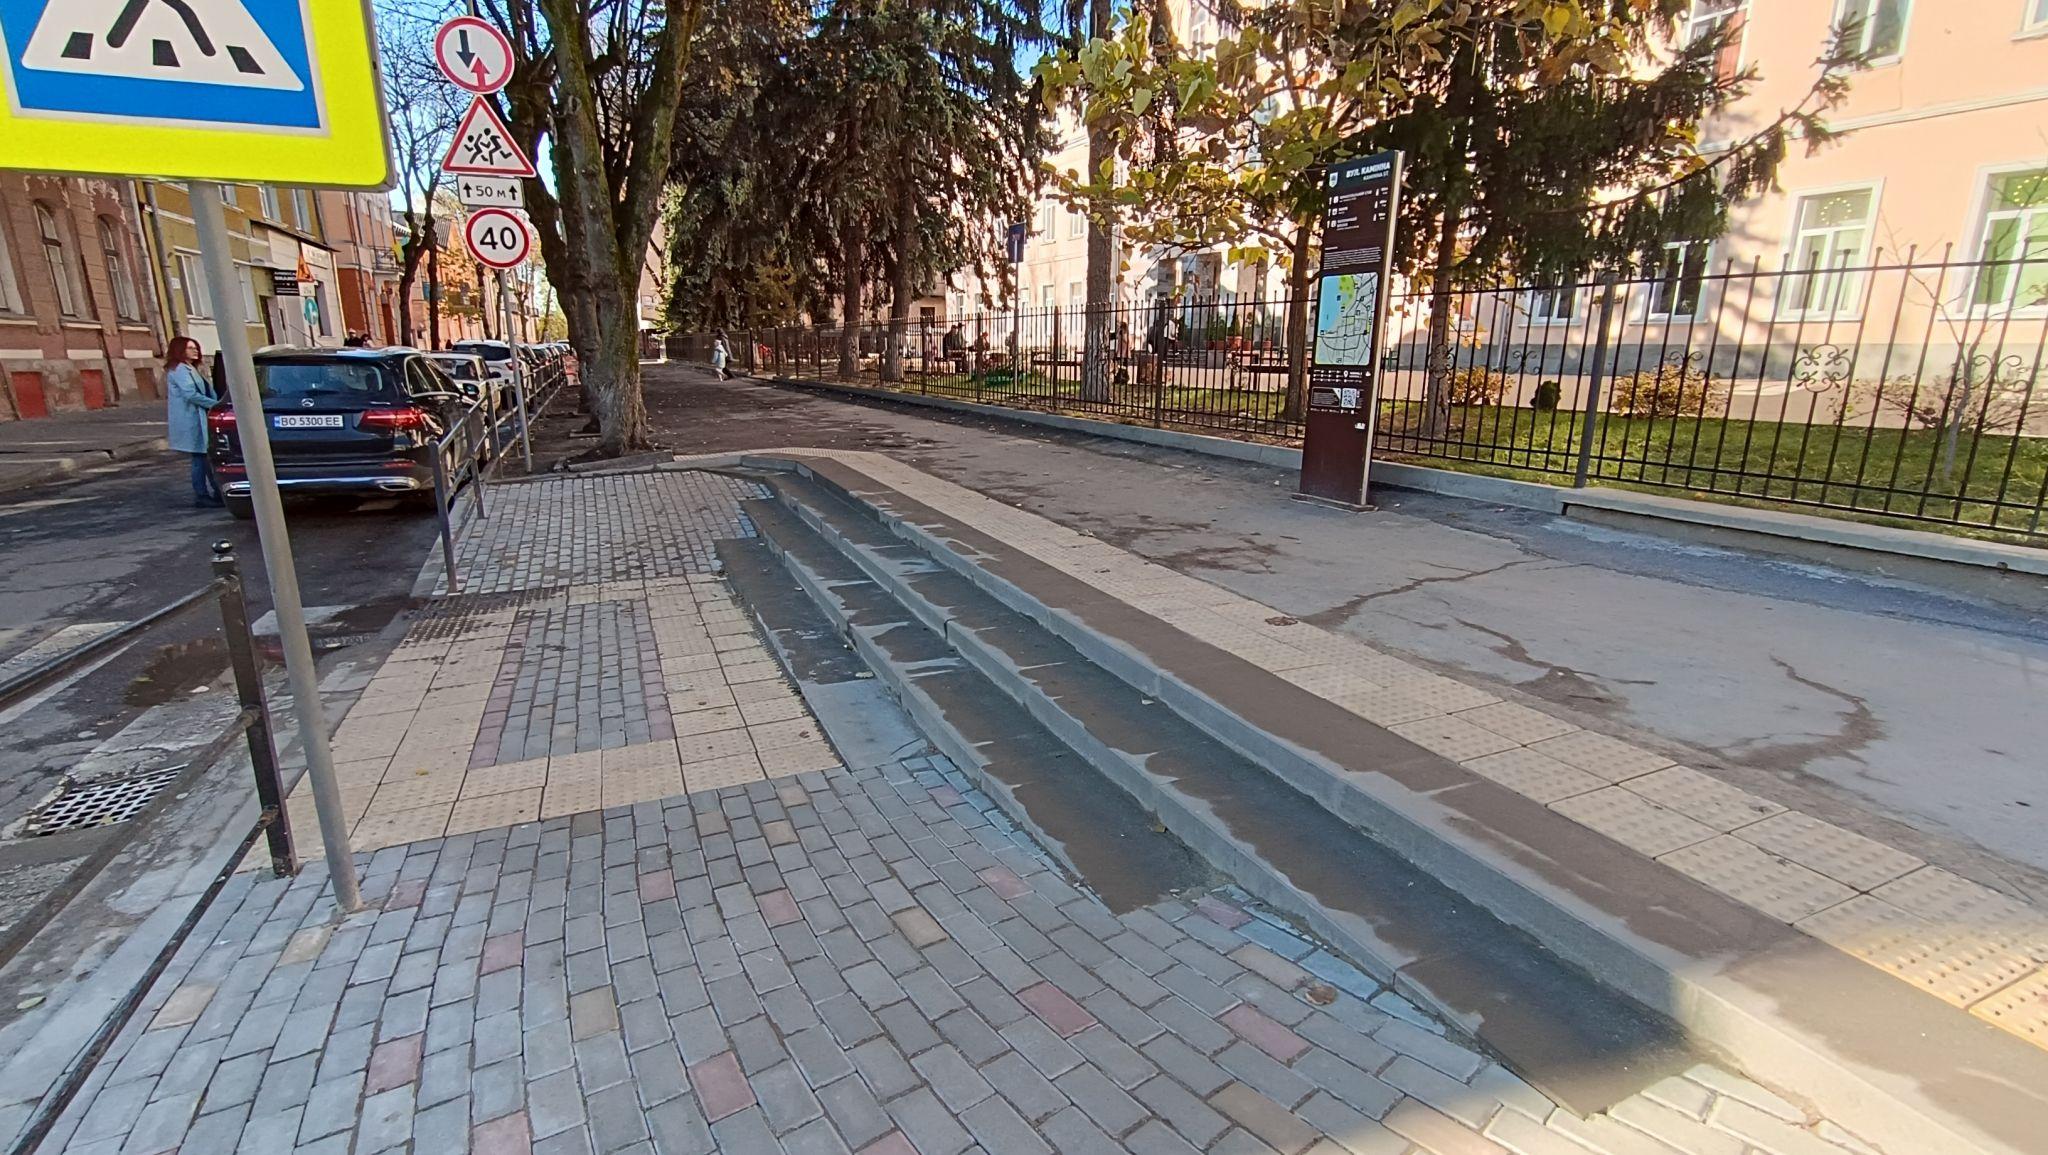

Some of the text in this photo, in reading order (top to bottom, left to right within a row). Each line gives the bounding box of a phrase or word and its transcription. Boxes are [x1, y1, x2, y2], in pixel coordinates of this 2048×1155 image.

[476, 186, 493, 197] 50
[479, 227, 516, 250] 40
[281, 416, 341, 427] BO 5300 EE
